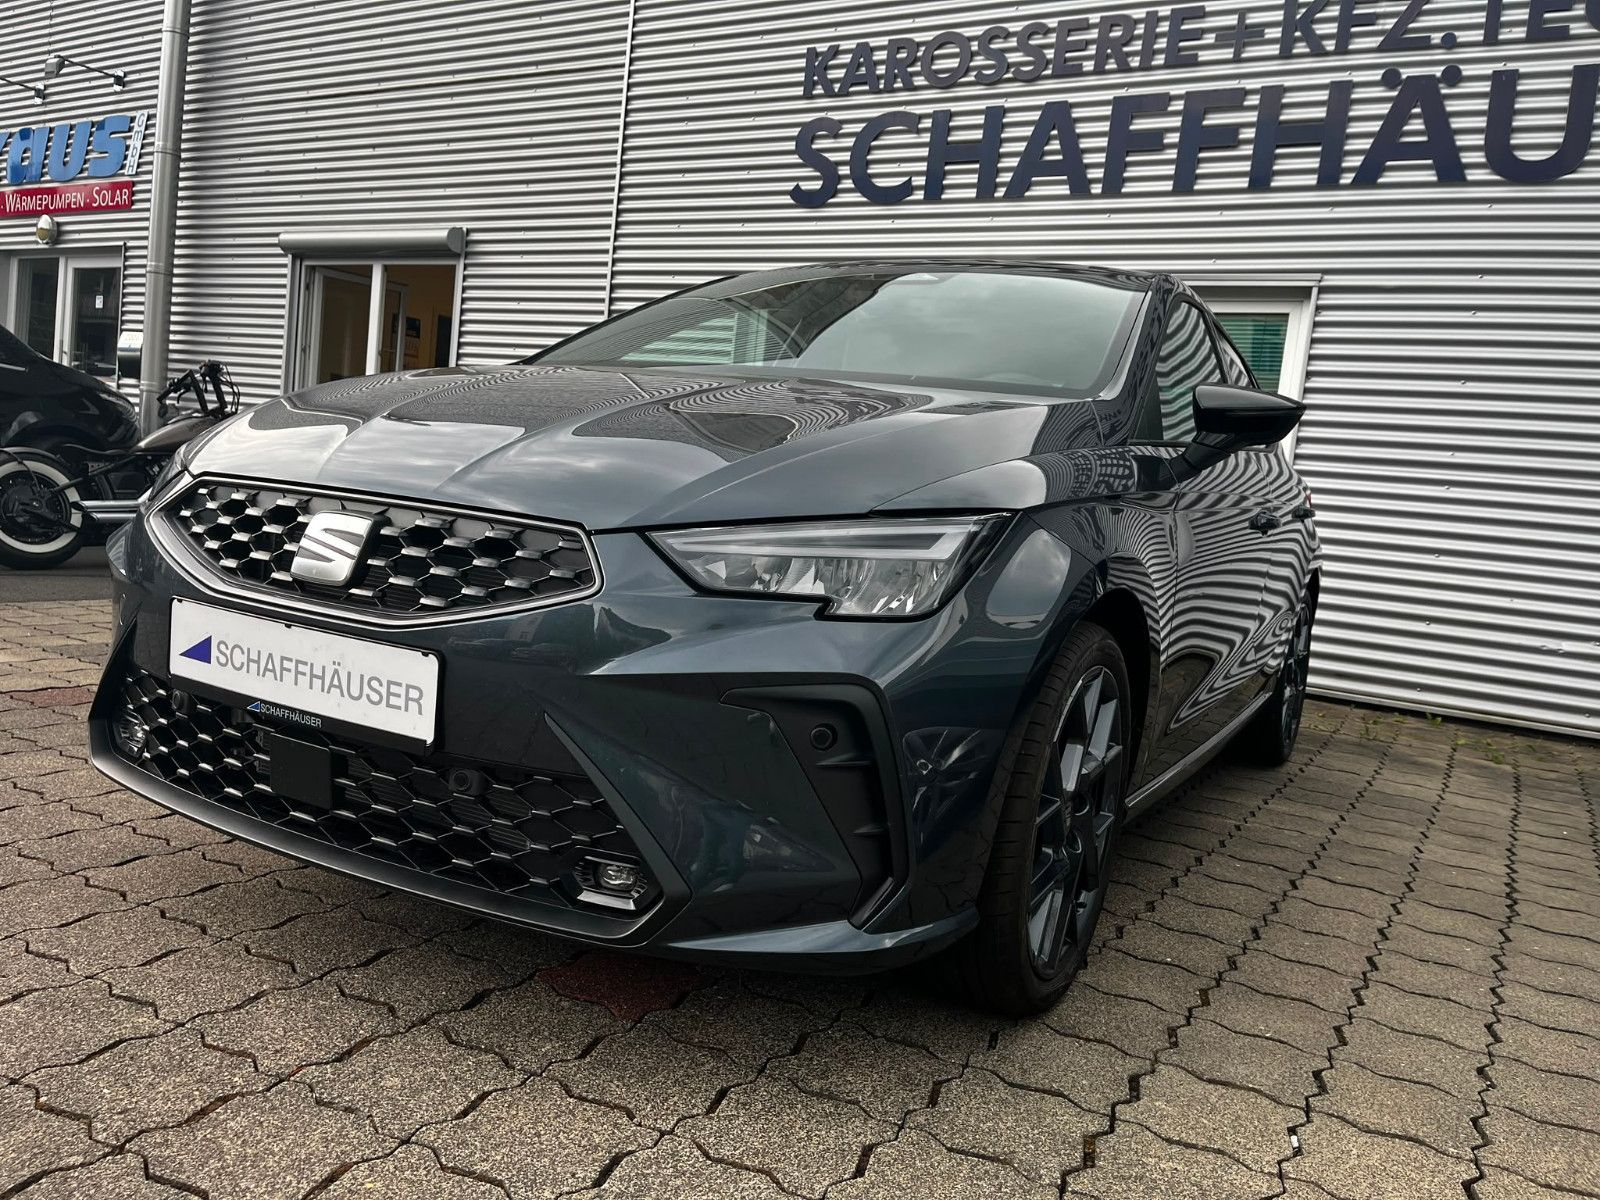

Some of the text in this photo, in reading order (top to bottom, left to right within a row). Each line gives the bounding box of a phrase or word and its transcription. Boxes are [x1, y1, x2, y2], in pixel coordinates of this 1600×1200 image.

[804, 7, 1206, 97] KAROSSERIE
[127, 112, 147, 175] GmbH
[789, 64, 1600, 208] SCHAFFHÄU
[215, 640, 424, 716] SCHAFFHÄUSER
[260, 703, 322, 728] SCHAFFHÄUSER
